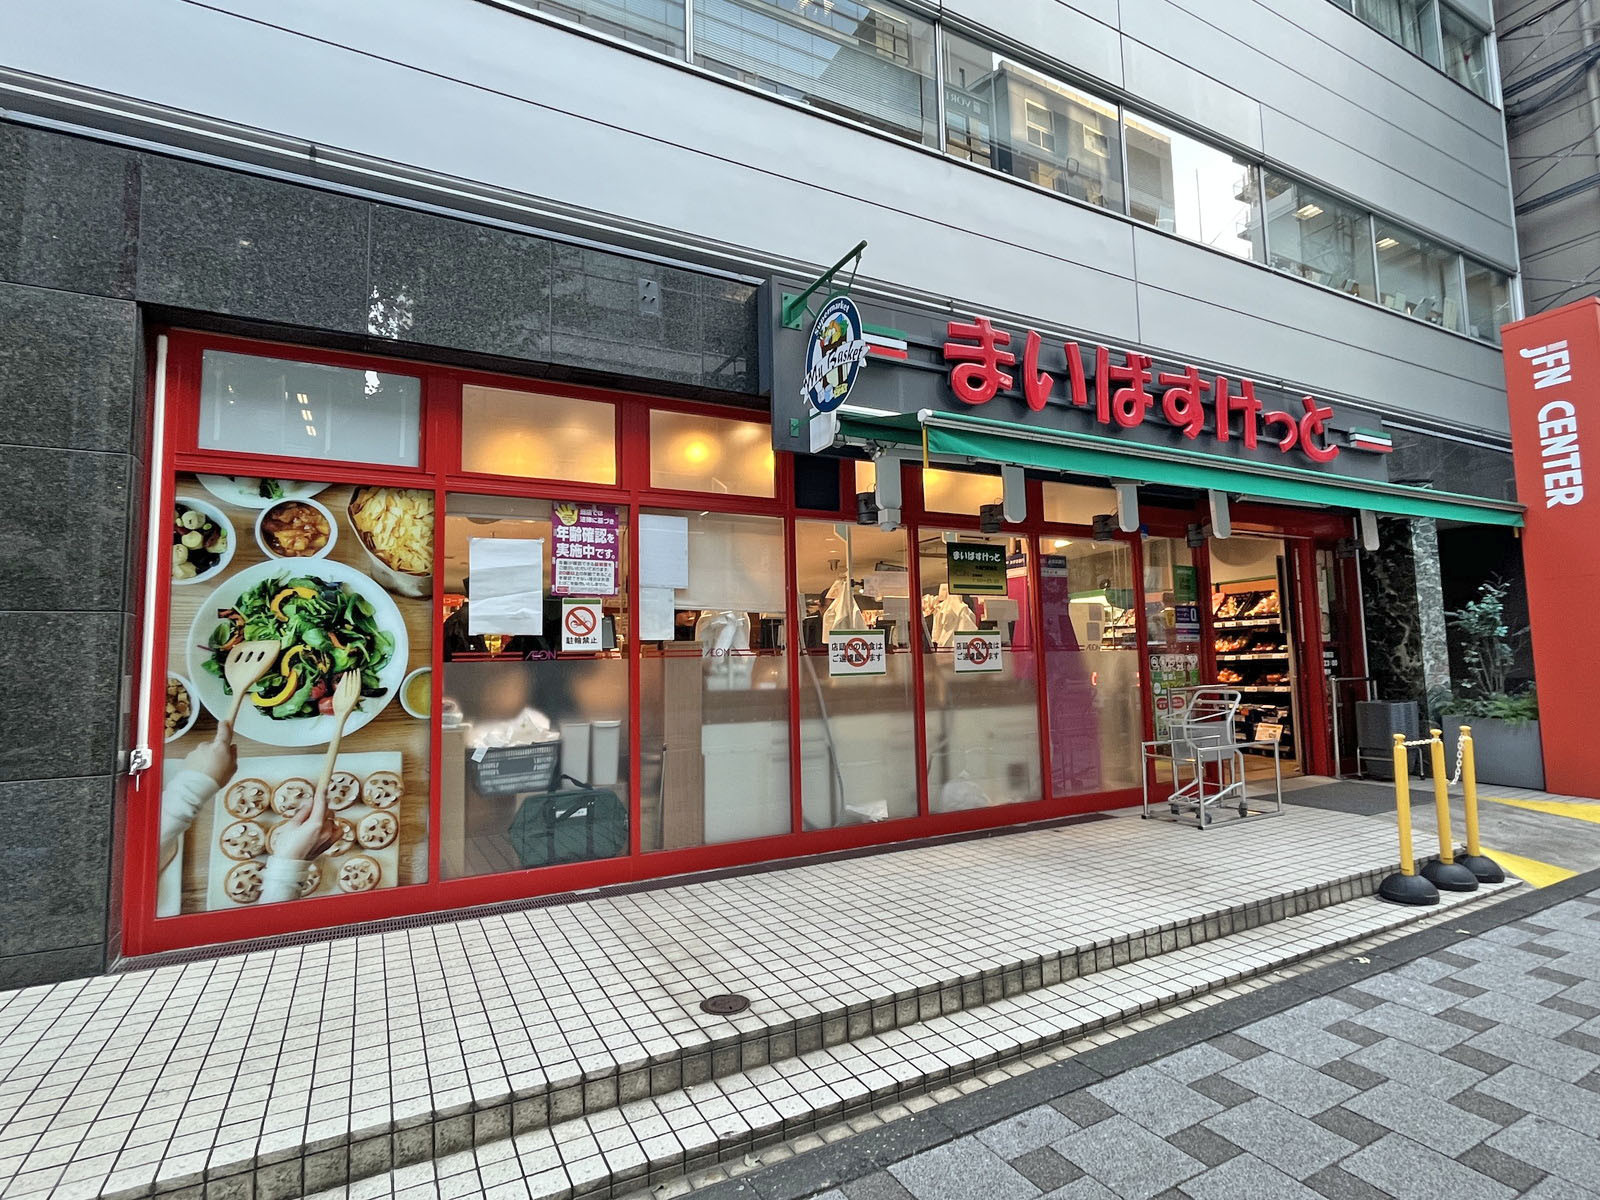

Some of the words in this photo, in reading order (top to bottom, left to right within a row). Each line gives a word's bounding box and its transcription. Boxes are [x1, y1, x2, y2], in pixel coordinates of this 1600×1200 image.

[827, 340, 863, 367] Basket
[943, 316, 1339, 463] まいばすけっと
[1537, 400, 1584, 509] CENTER
[556, 525, 615, 544] 年齢確認を
[556, 543, 615, 559] 実施中です。
[953, 551, 1001, 562] まいばすけっと
[566, 636, 598, 644] 駐輪禁止
[832, 653, 883, 663] ご遠慮願ます
[956, 652, 999, 661] ご遠慮願ます
